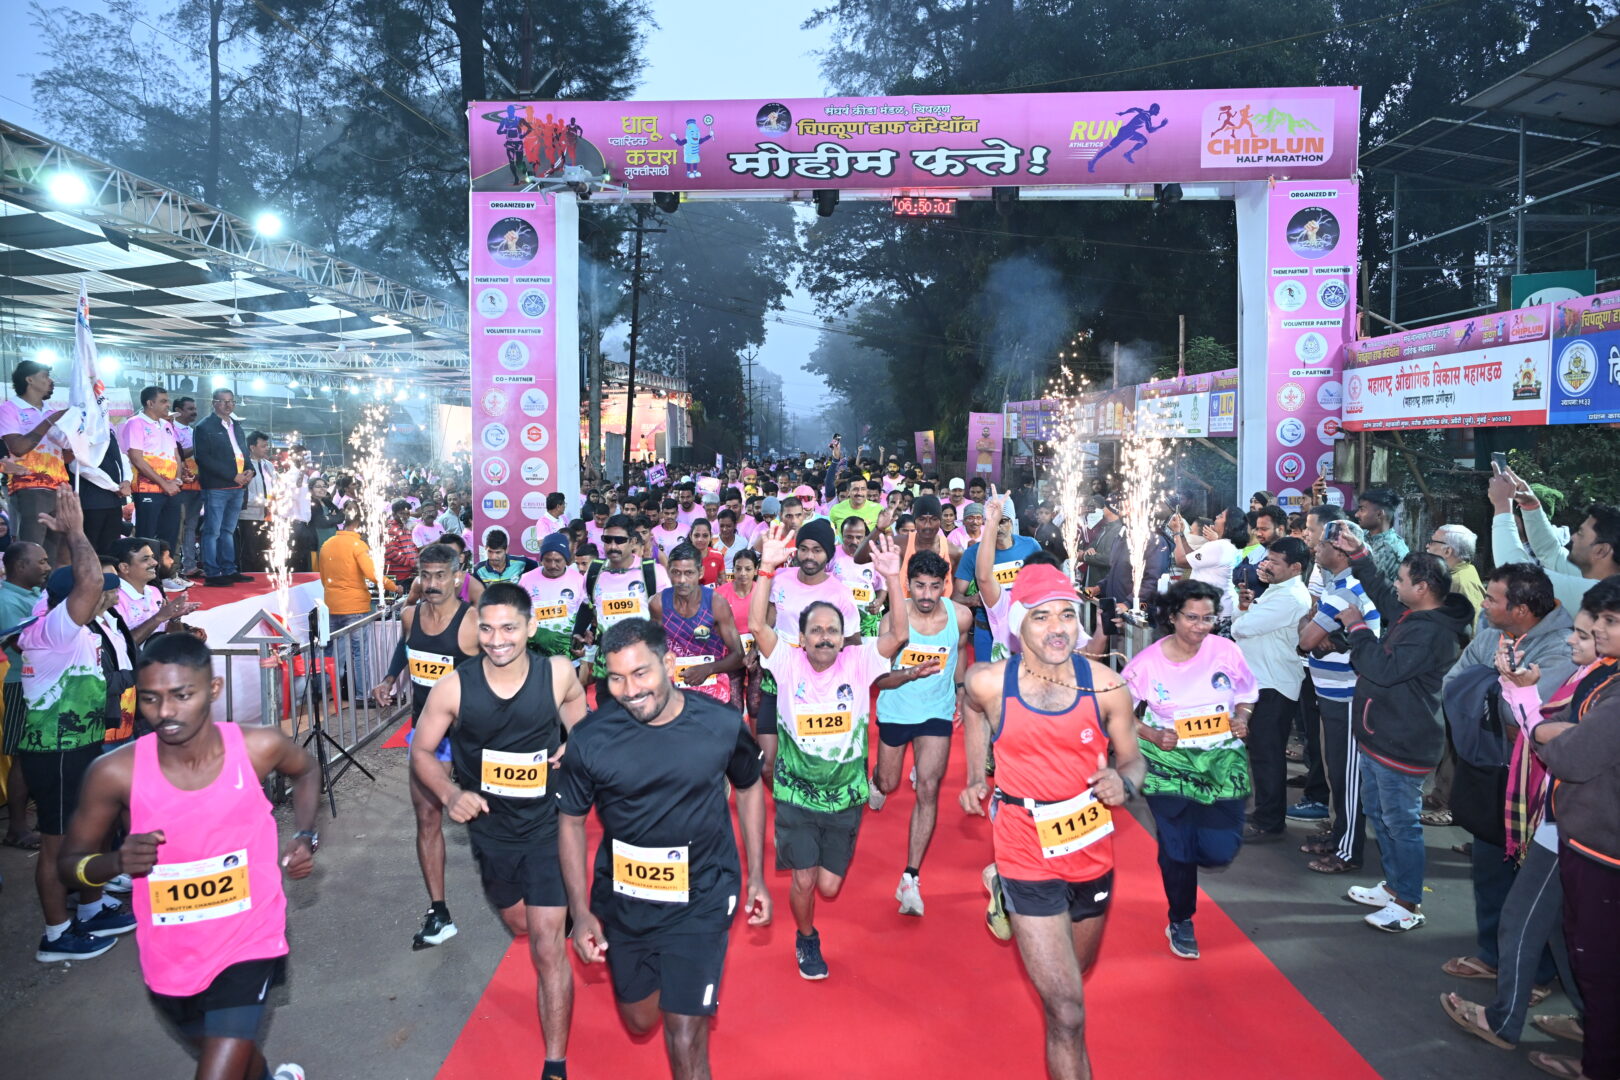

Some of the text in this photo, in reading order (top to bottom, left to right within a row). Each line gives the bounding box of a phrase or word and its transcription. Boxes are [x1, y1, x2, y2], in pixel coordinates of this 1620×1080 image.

[824, 103, 950, 117] संघर्ष क्रीडा मंडळ, चिपळूण
[621, 116, 663, 141] धावू
[797, 116, 980, 139] चिपळूण हाफ मॅरेथॉन
[1069, 120, 1122, 141] RUN
[608, 137, 648, 147] प्लास्टिक
[1207, 137, 1324, 155] CHIPLUN
[625, 149, 677, 165] कचरा
[728, 141, 900, 179] मोहीम
[1236, 154, 1324, 163] HALF MARATHON
[897, 201, 952, 214] 06:50:01
[1581, 309, 1611, 330] चिपळूण
[1511, 325, 1543, 336] CHIPLUN
[1367, 355, 1502, 396] महाराष्ट्र औद्योगिक विकास महामंडळ
[1221, 396, 1232, 413] LIC
[494, 500, 508, 508] LIC
[540, 608, 562, 616] 1115
[608, 601, 633, 610] 1099
[415, 662, 446, 675] 1127
[806, 715, 843, 728] 1128
[1184, 717, 1222, 732] 1117
[493, 767, 538, 780] 1020
[1052, 806, 1099, 836] 1113
[625, 862, 675, 881] 1025
[167, 875, 234, 902] 1002
